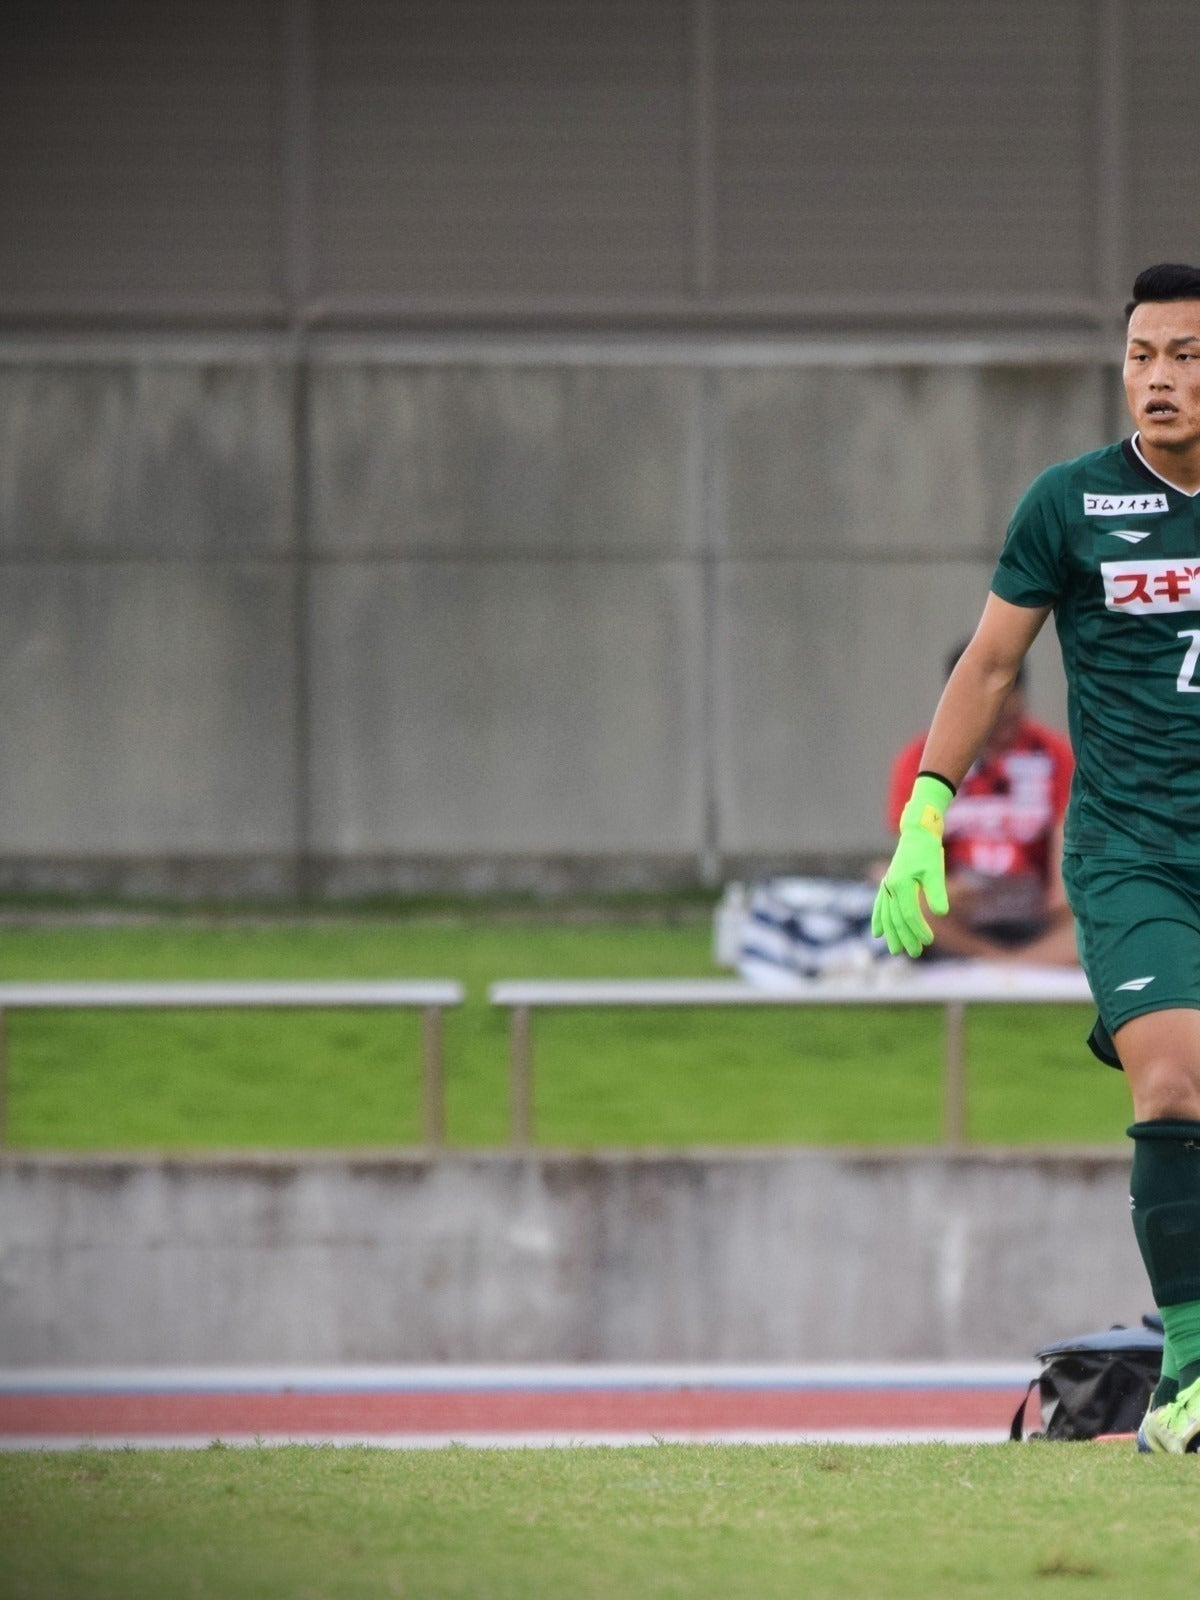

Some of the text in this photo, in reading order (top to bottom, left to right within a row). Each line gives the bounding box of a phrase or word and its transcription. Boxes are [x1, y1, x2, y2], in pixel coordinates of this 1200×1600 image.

[1086, 498, 1164, 510] ゴムノイナキ
